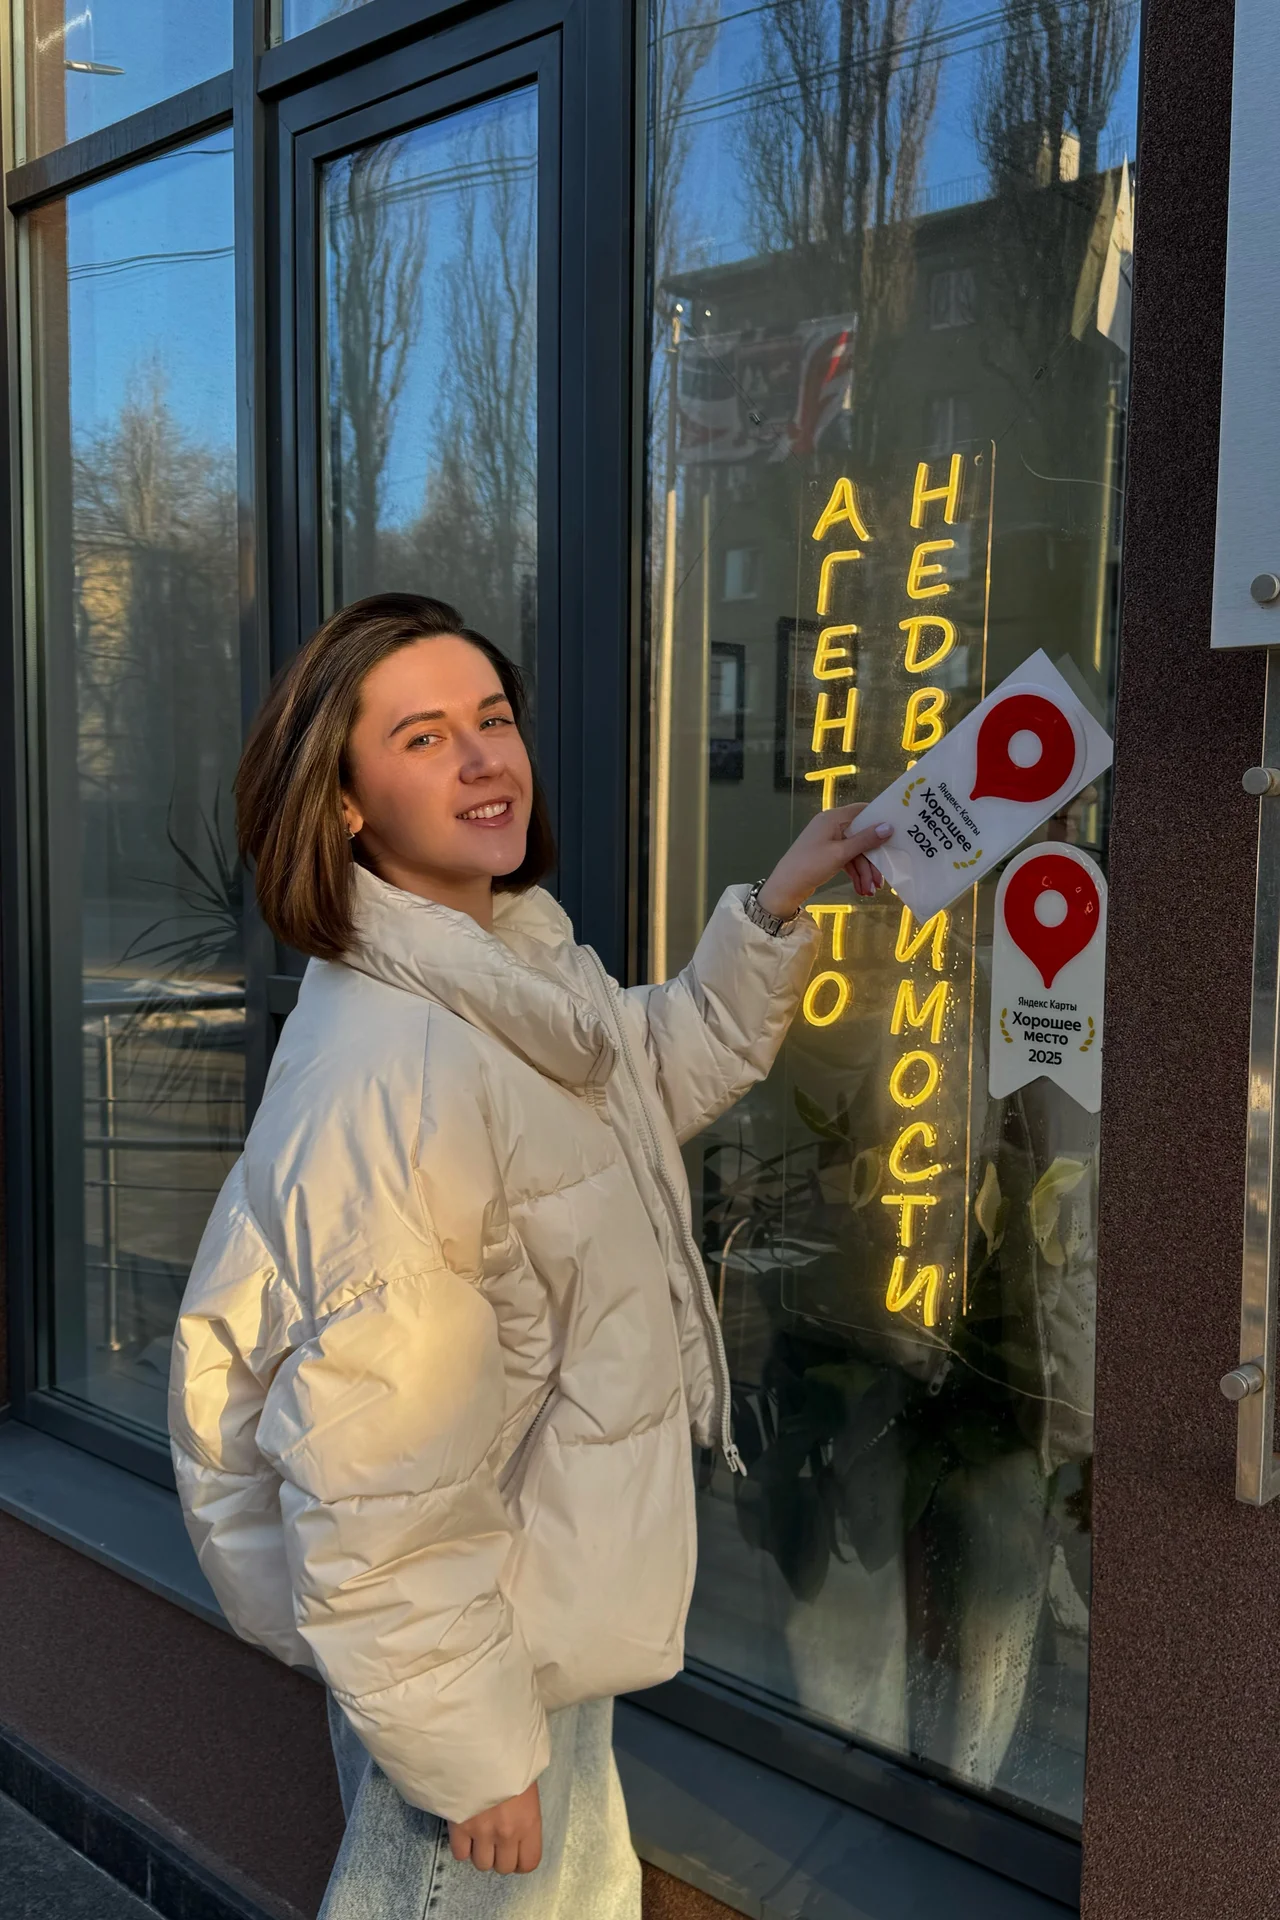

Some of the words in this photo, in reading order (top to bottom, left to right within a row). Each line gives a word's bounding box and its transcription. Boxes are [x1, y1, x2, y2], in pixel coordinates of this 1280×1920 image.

[805, 477, 868, 811] АГЕНТ
[920, 787, 972, 852] Хорошее
[938, 782, 961, 812] Яндекс
[959, 809, 980, 836] Карты
[907, 824, 938, 858] 2026
[918, 809, 953, 850] место
[881, 453, 961, 1326] НЕДВИМОСТИ
[1012, 1011, 1082, 1031] Хорошее
[1018, 997, 1048, 1008] Яндекс
[1050, 1000, 1077, 1011] Карты
[1024, 1031, 1068, 1045] место
[1028, 1049, 1062, 1065] 2025
